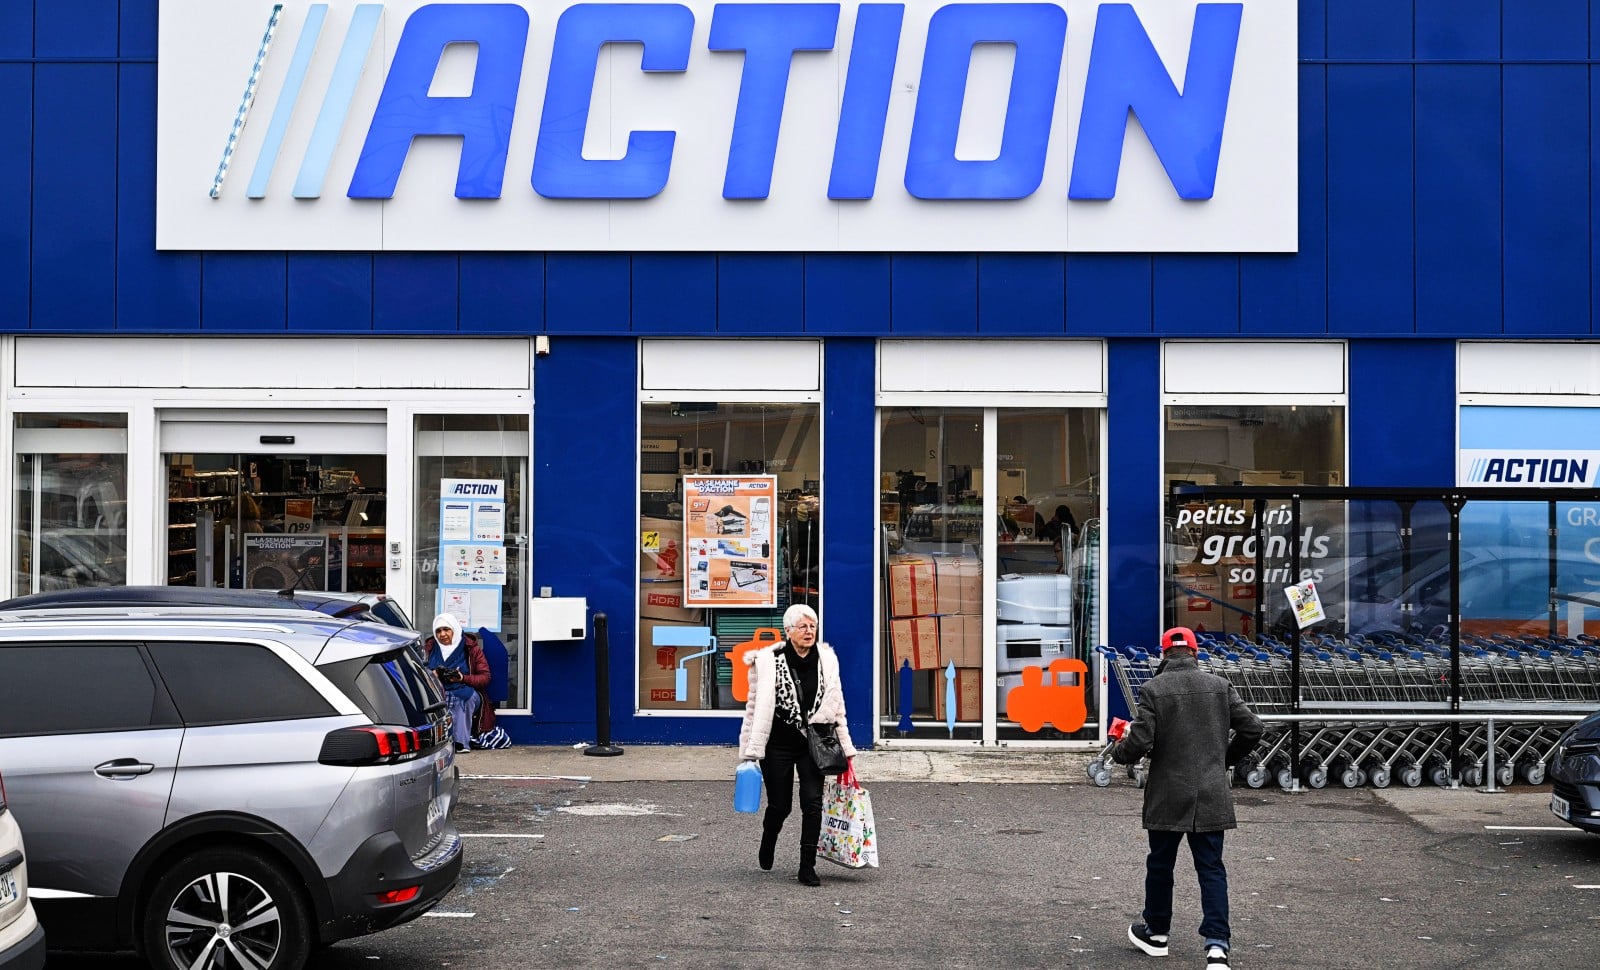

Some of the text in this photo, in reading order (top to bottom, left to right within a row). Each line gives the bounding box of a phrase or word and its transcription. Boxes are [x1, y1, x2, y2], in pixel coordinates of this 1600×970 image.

[347, 2, 1244, 201] ACTION
[1483, 458, 1589, 483] ACTION
[454, 483, 498, 495] ACTION
[1176, 504, 1246, 529] petits
[1201, 526, 1330, 565] grands
